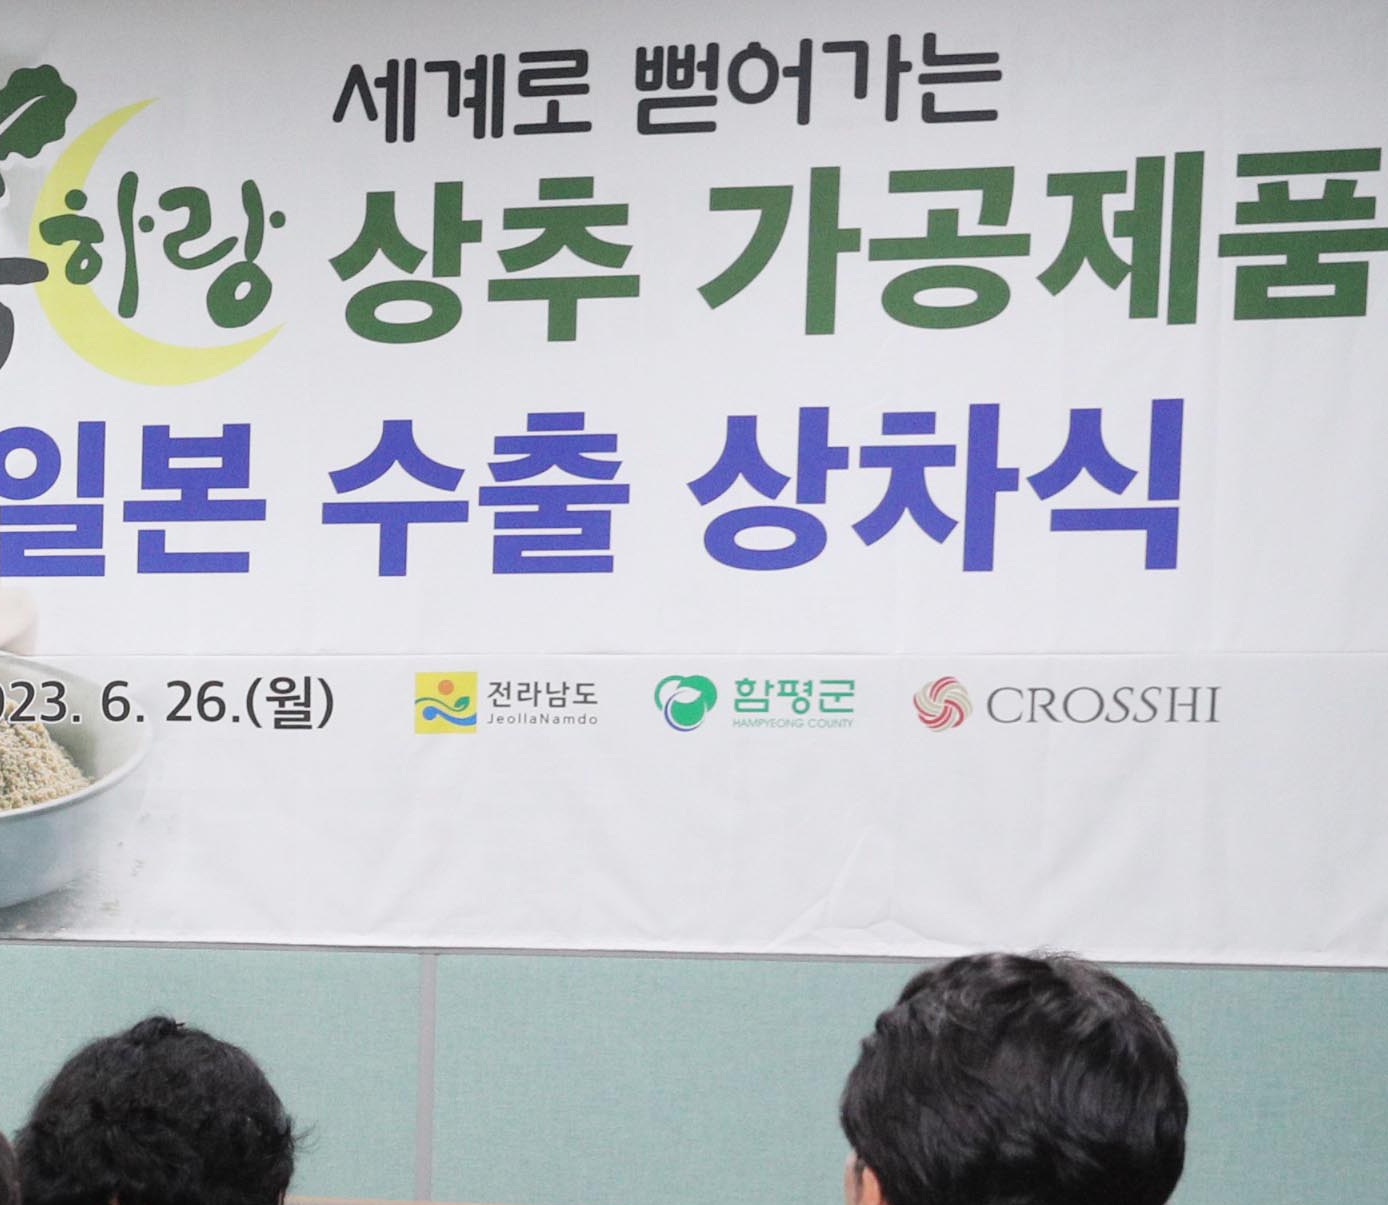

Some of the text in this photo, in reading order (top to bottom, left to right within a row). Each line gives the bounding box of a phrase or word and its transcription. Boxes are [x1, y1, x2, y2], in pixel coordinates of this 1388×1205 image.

[332, 32, 1003, 144] 세계로 뻗어가는
[328, 175, 641, 345] 상추
[697, 147, 1388, 336] 가공제품
[321, 411, 631, 577] 수출
[686, 398, 1185, 572] 상차식
[101, 680, 144, 723] 6.
[166, 676, 334, 730] 26.(월)
[487, 680, 598, 708] 전라남도
[733, 677, 856, 716] 함평군
[986, 686, 1221, 724] CROSSHI
[487, 712, 598, 725] JeollaNamdo
[732, 717, 854, 729] HAMPYEONG COUNTY
